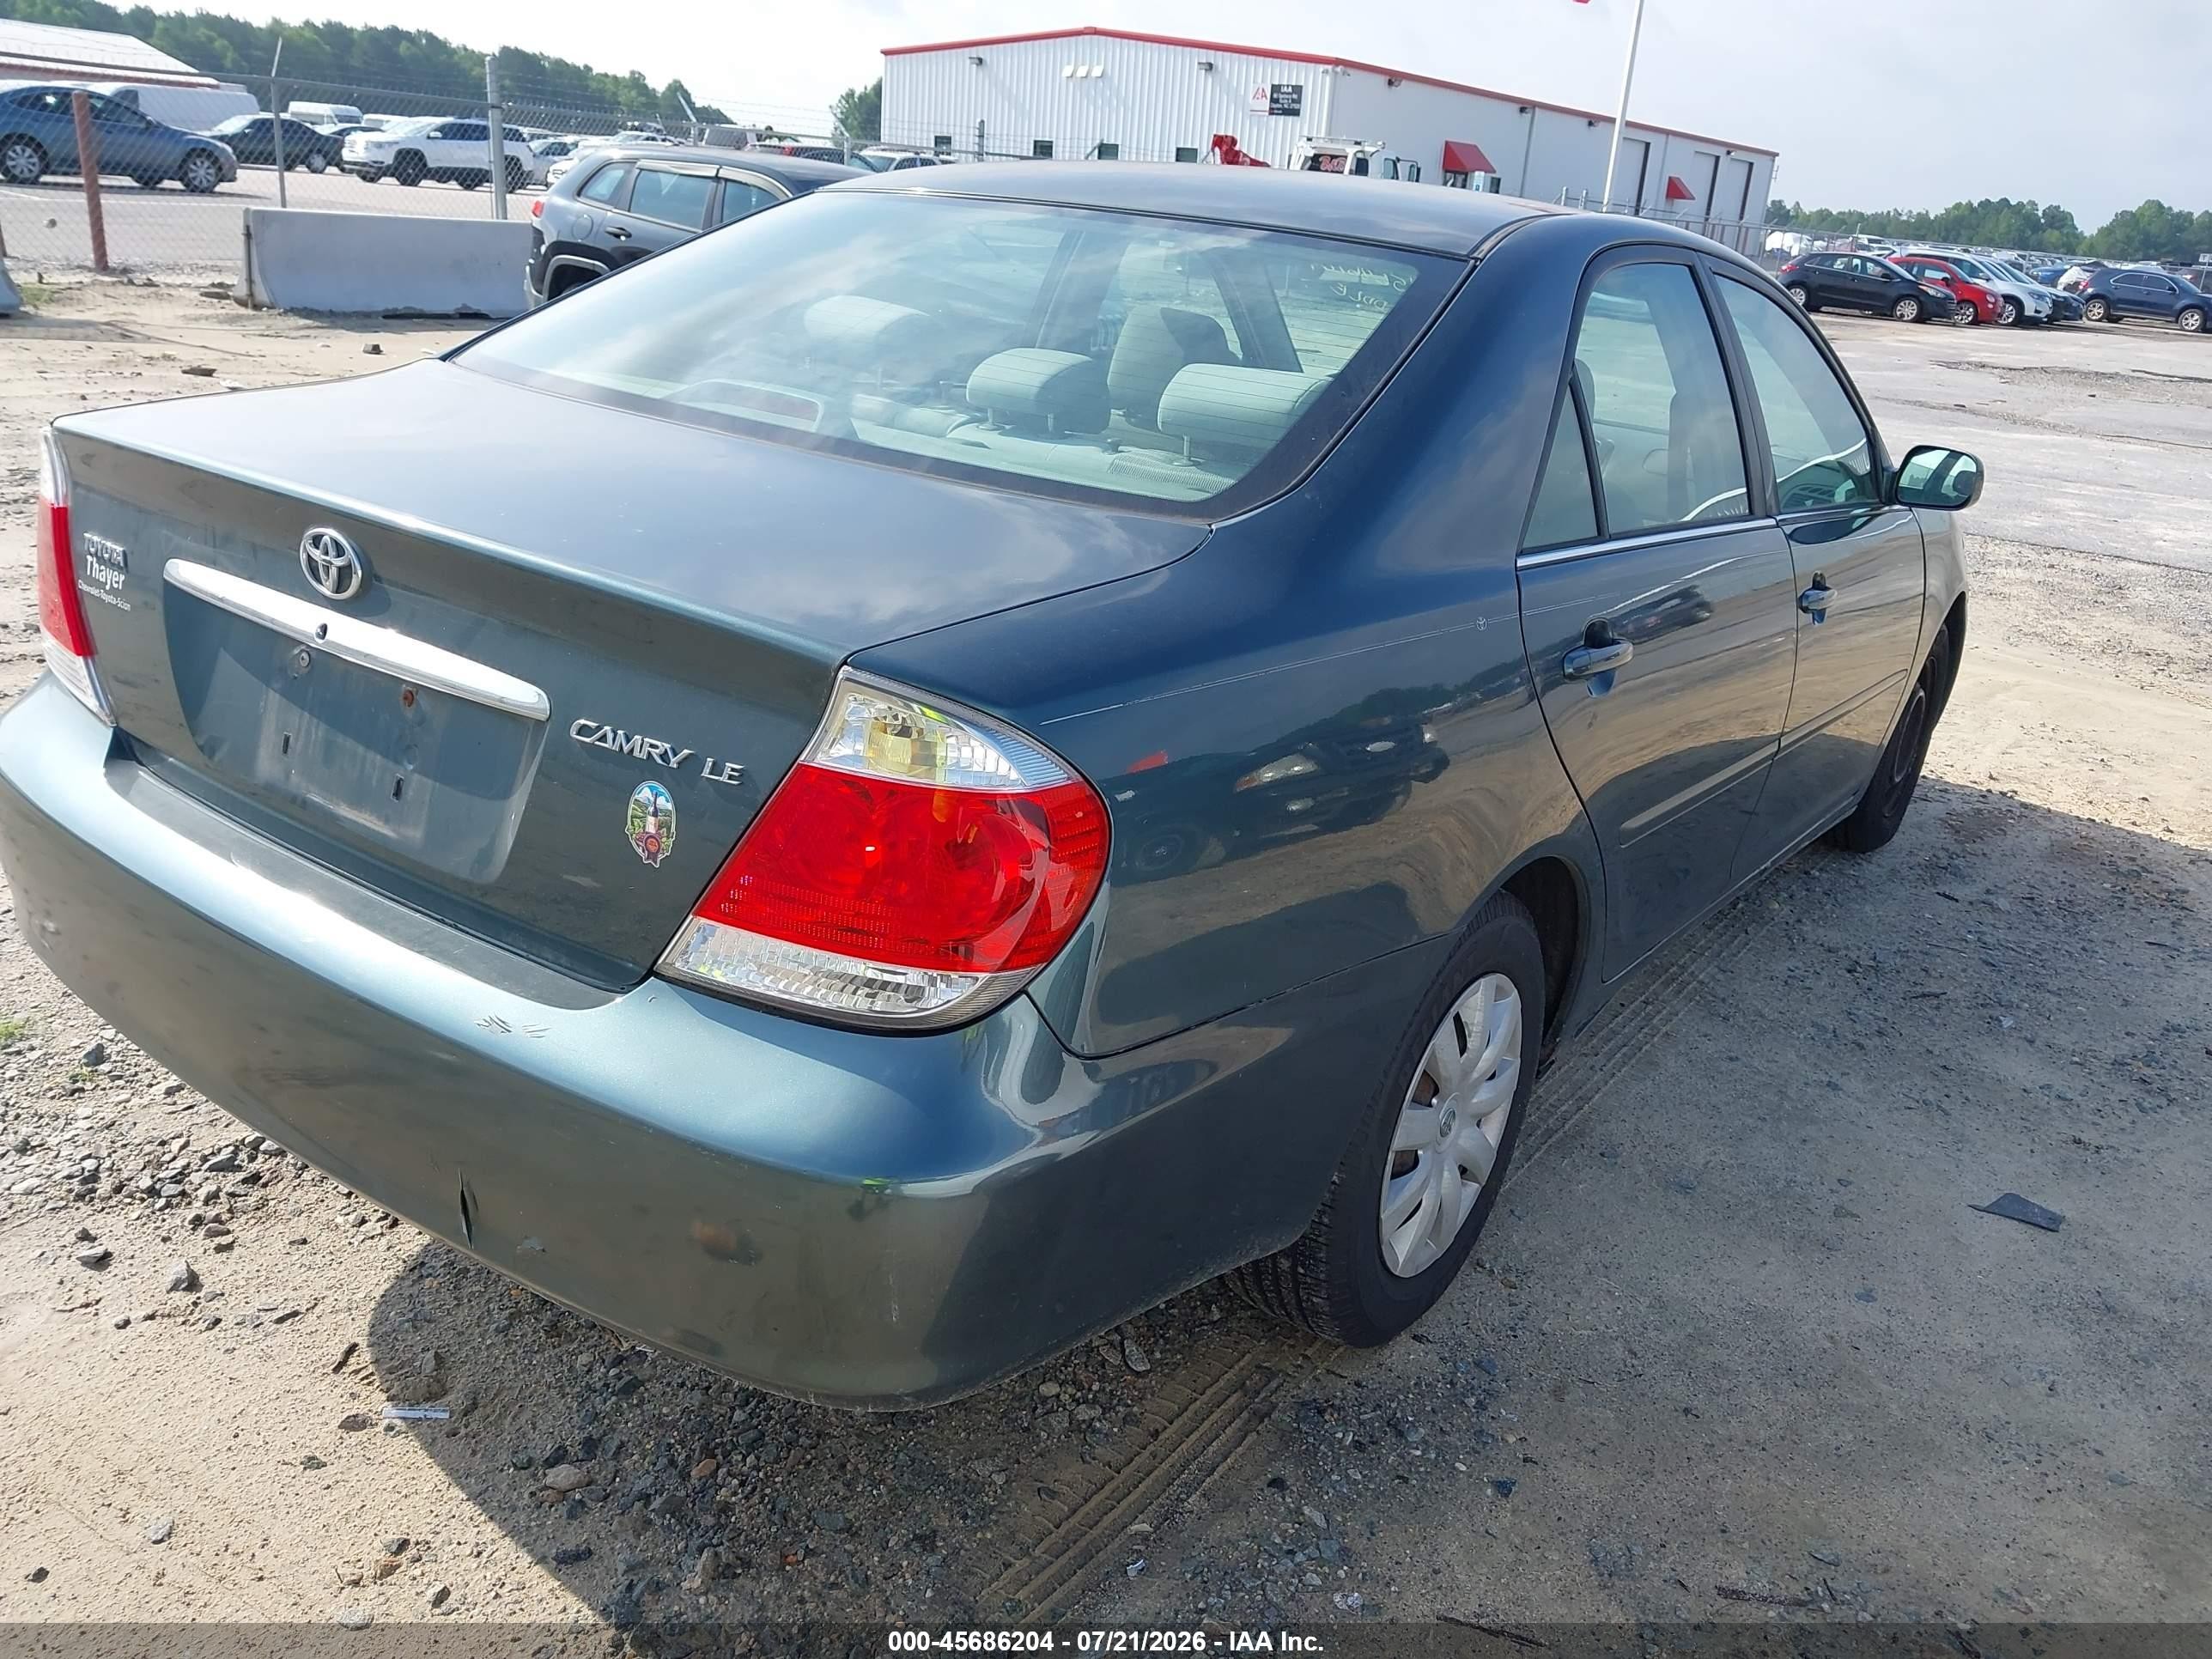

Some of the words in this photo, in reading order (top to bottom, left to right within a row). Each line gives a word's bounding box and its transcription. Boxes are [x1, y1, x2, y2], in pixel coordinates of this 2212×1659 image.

[86, 555, 125, 591] Thayer
[569, 719, 696, 769] CAMRY
[701, 757, 746, 785] LE
